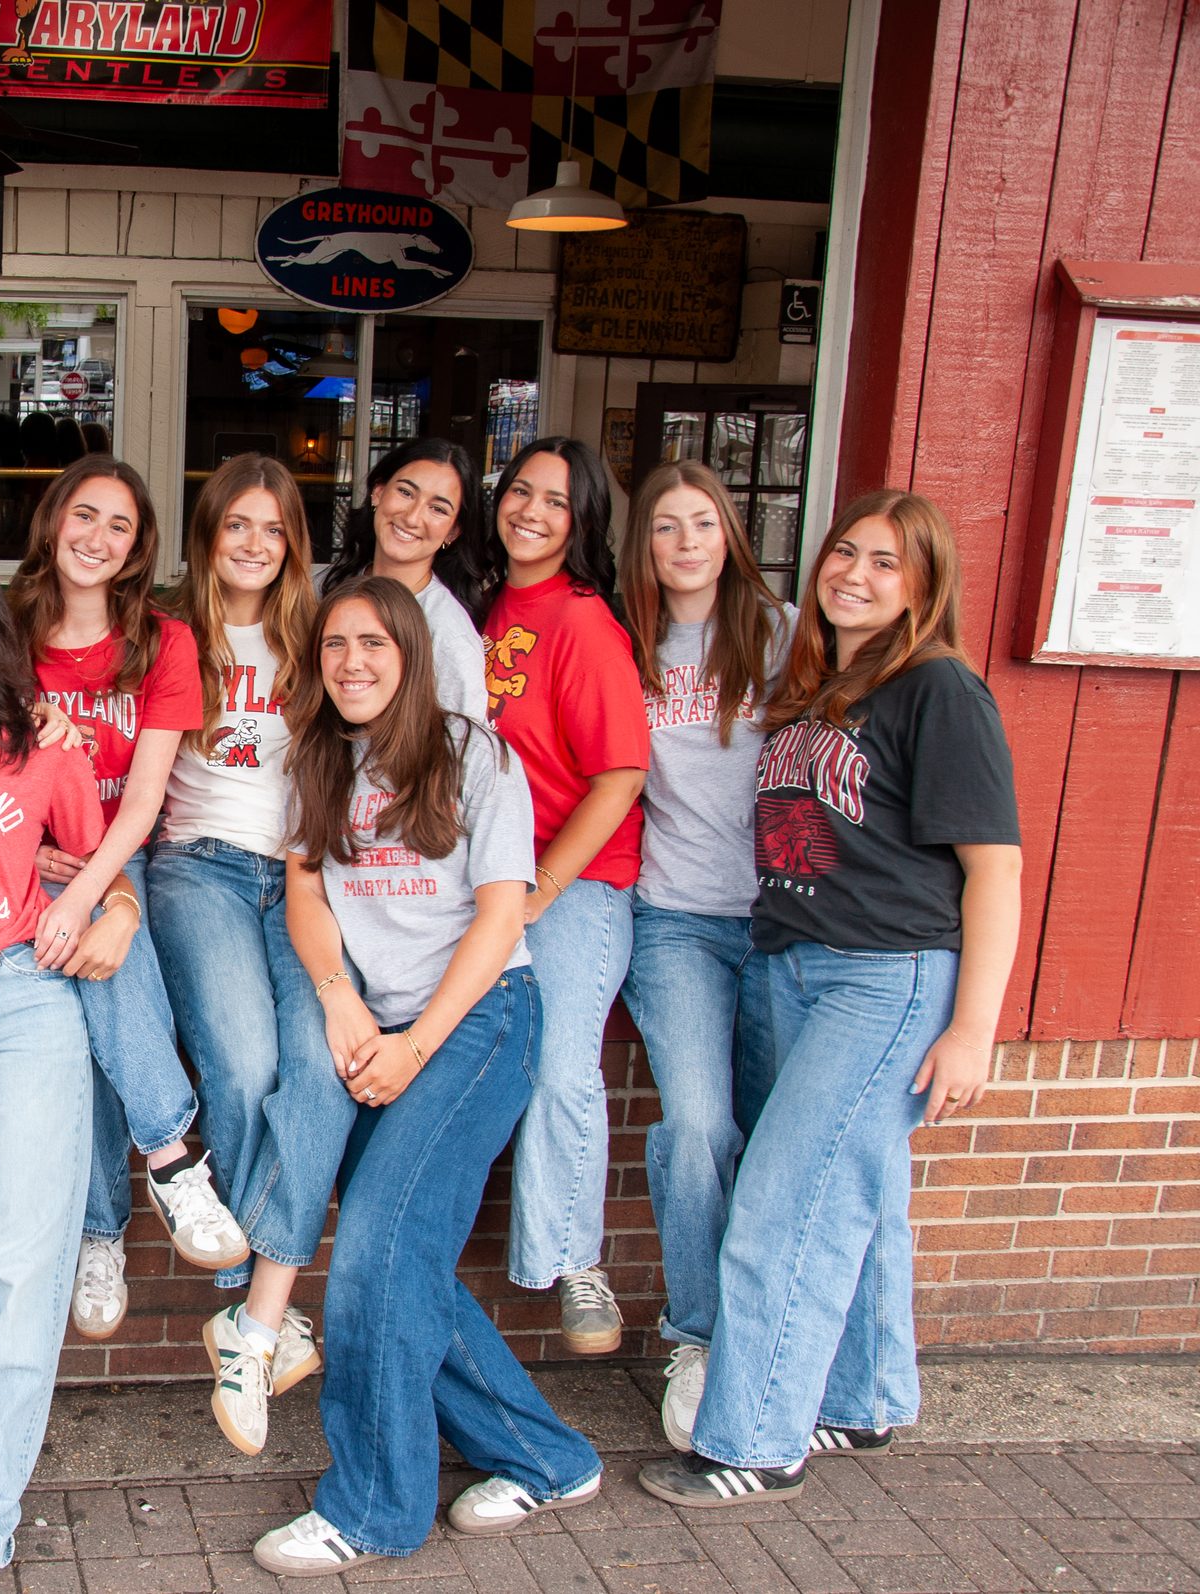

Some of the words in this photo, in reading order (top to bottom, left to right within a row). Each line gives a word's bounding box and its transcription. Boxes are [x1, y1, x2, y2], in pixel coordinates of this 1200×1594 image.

[302, 200, 434, 227] GREYHOUND
[331, 275, 396, 298] LINES
[573, 286, 703, 313] BRANCHVILLE
[225, 744, 260, 767] M
[343, 878, 438, 897] MARYLAND
